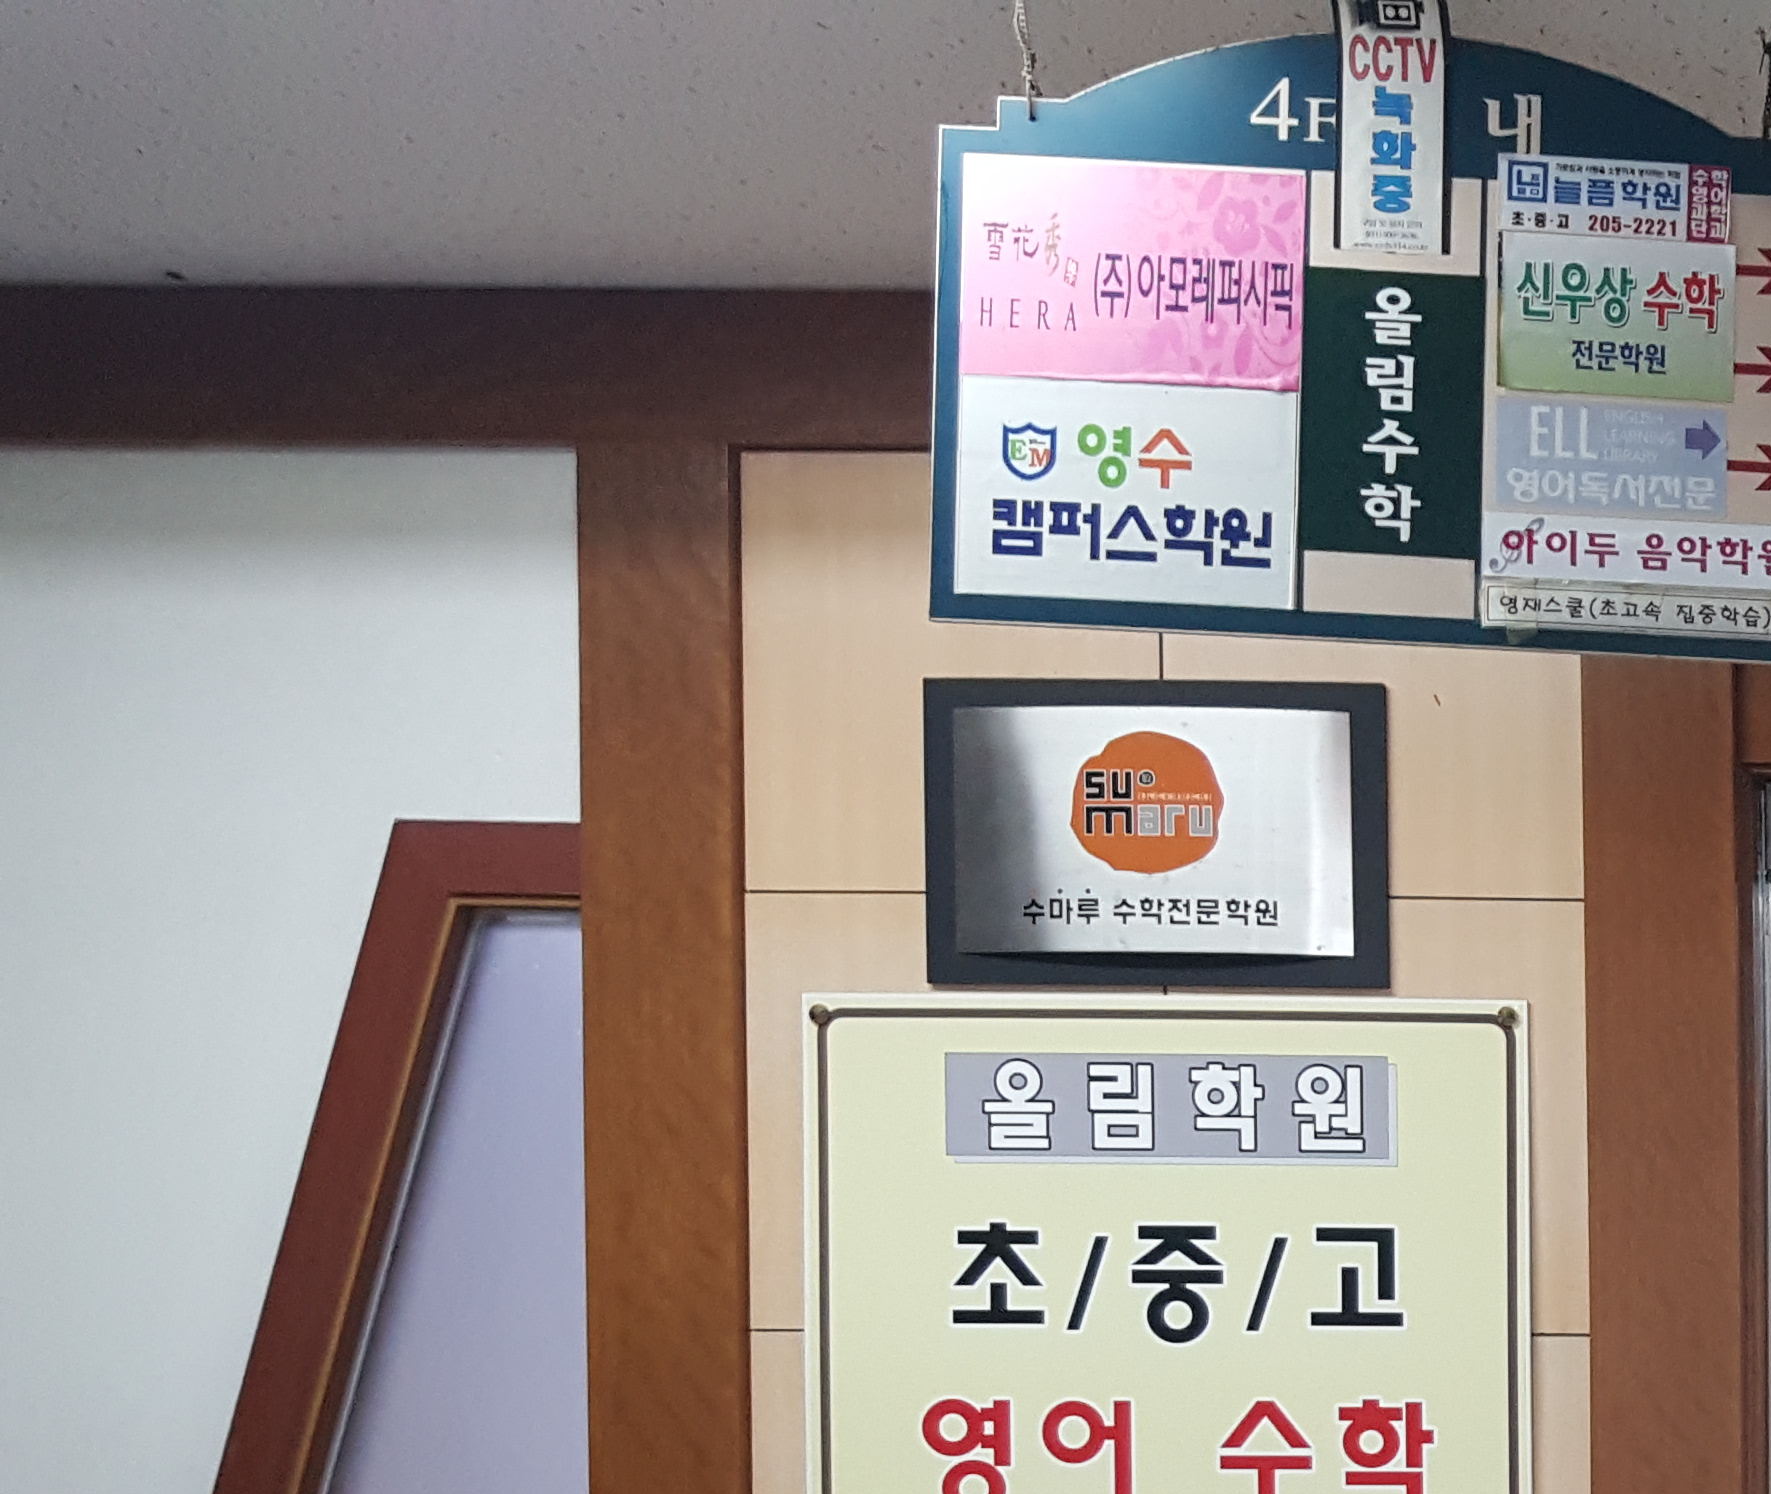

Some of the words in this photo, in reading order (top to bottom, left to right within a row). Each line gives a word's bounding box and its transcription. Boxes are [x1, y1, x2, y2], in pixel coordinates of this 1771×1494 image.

[1349, 34, 1437, 83] CCTV
[1370, 85, 1417, 214] 녹화중
[1553, 176, 1682, 211] 늘품학원
[1588, 214, 1678, 237] 205-2221
[980, 297, 1077, 332] HERA
[1094, 252, 1295, 330] (주)아모레퍼시픽
[1517, 261, 1637, 327] 신우상
[1643, 270, 1724, 333] 수학
[1571, 339, 1667, 375] 전문학원
[1360, 286, 1423, 543] 올림수학
[1529, 404, 1599, 459] ELL
[1077, 423, 1193, 489] 영수
[1507, 467, 1718, 510] 영어독서전문
[992, 498, 1272, 569] 캠퍼스학원
[1501, 528, 1620, 568] 아이두
[1676, 603, 1771, 630] 집중학습)
[1022, 898, 1101, 927] 수마루
[1113, 897, 1279, 927] 수학전문학원
[981, 1057, 1367, 1153] 올림학원
[948, 1221, 1405, 1344] 초/중/고
